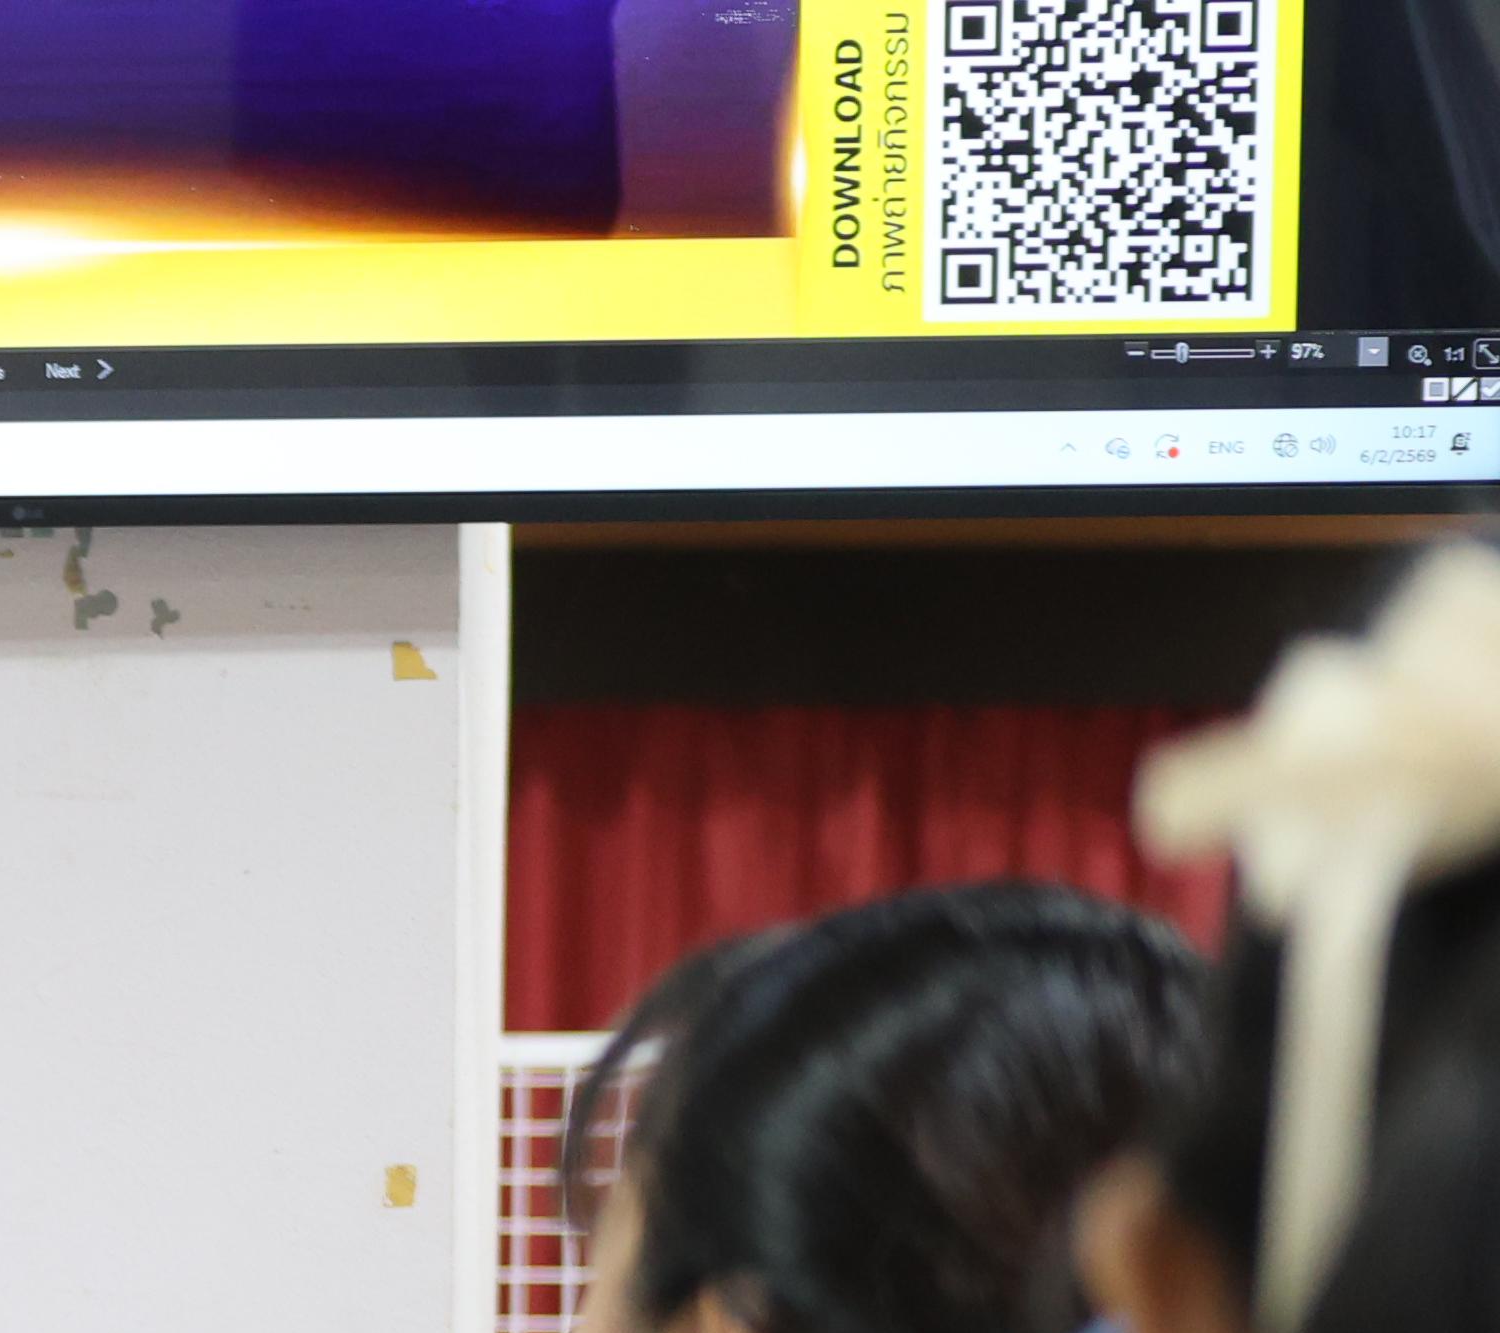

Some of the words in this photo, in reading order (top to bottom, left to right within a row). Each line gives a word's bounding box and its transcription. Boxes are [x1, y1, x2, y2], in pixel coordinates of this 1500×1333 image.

[832, 39, 863, 268] DOWNLOAD
[1290, 343, 1325, 360] 97%
[45, 362, 82, 379] Next
[1392, 425, 1437, 440] 10:17
[1208, 439, 1245, 455] ENG
[1360, 450, 1437, 466] 6/2/2569
